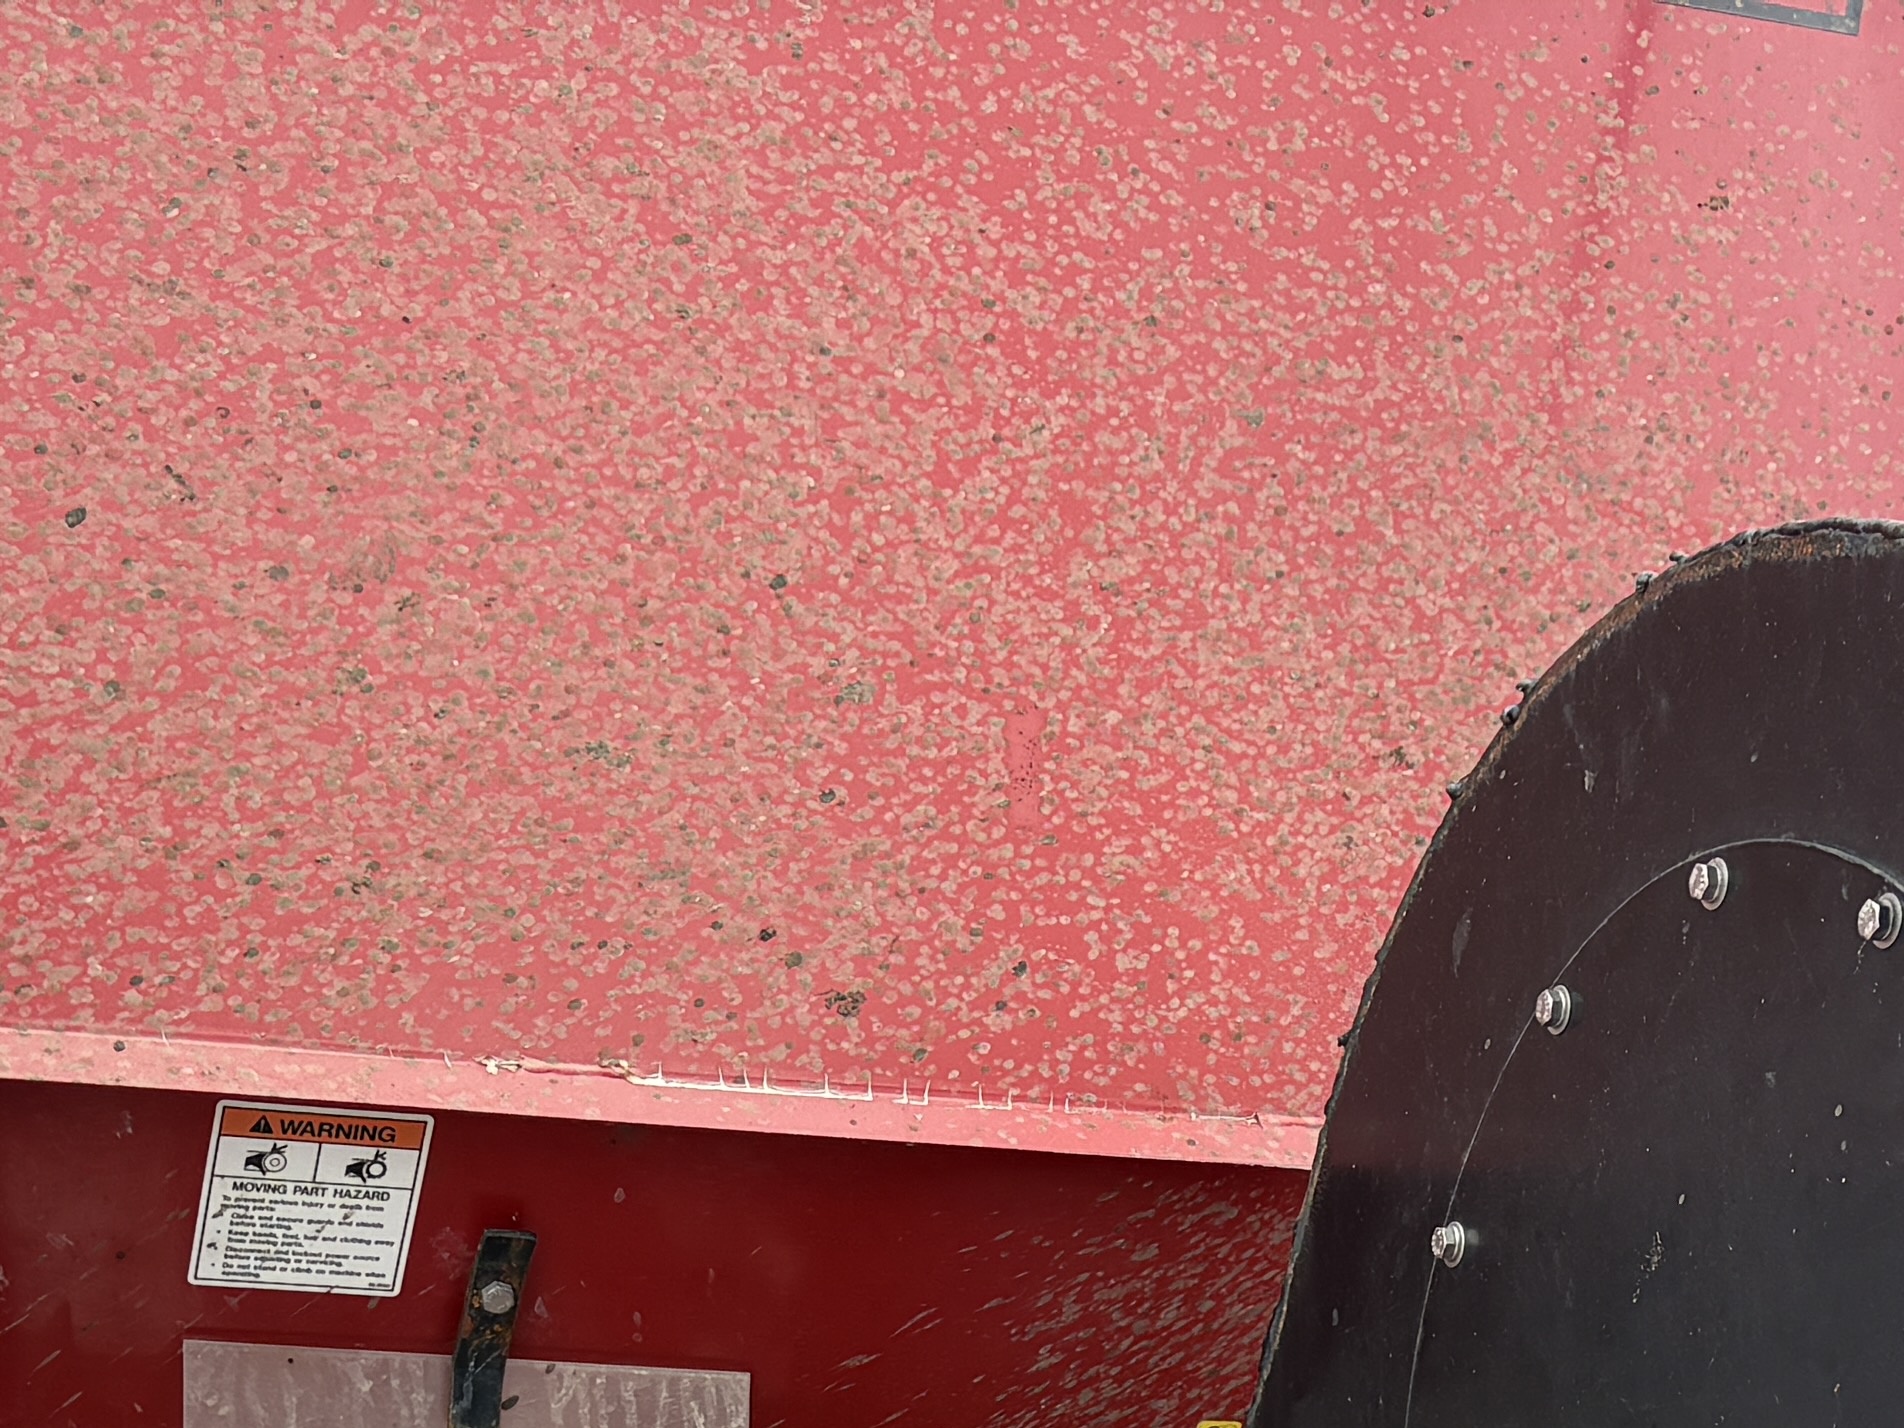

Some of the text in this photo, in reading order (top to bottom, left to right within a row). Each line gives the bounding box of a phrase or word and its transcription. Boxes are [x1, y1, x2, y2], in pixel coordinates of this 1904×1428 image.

[280, 1119, 396, 1143] WARNING
[232, 1181, 391, 1201] MOVING PART HAZARD
